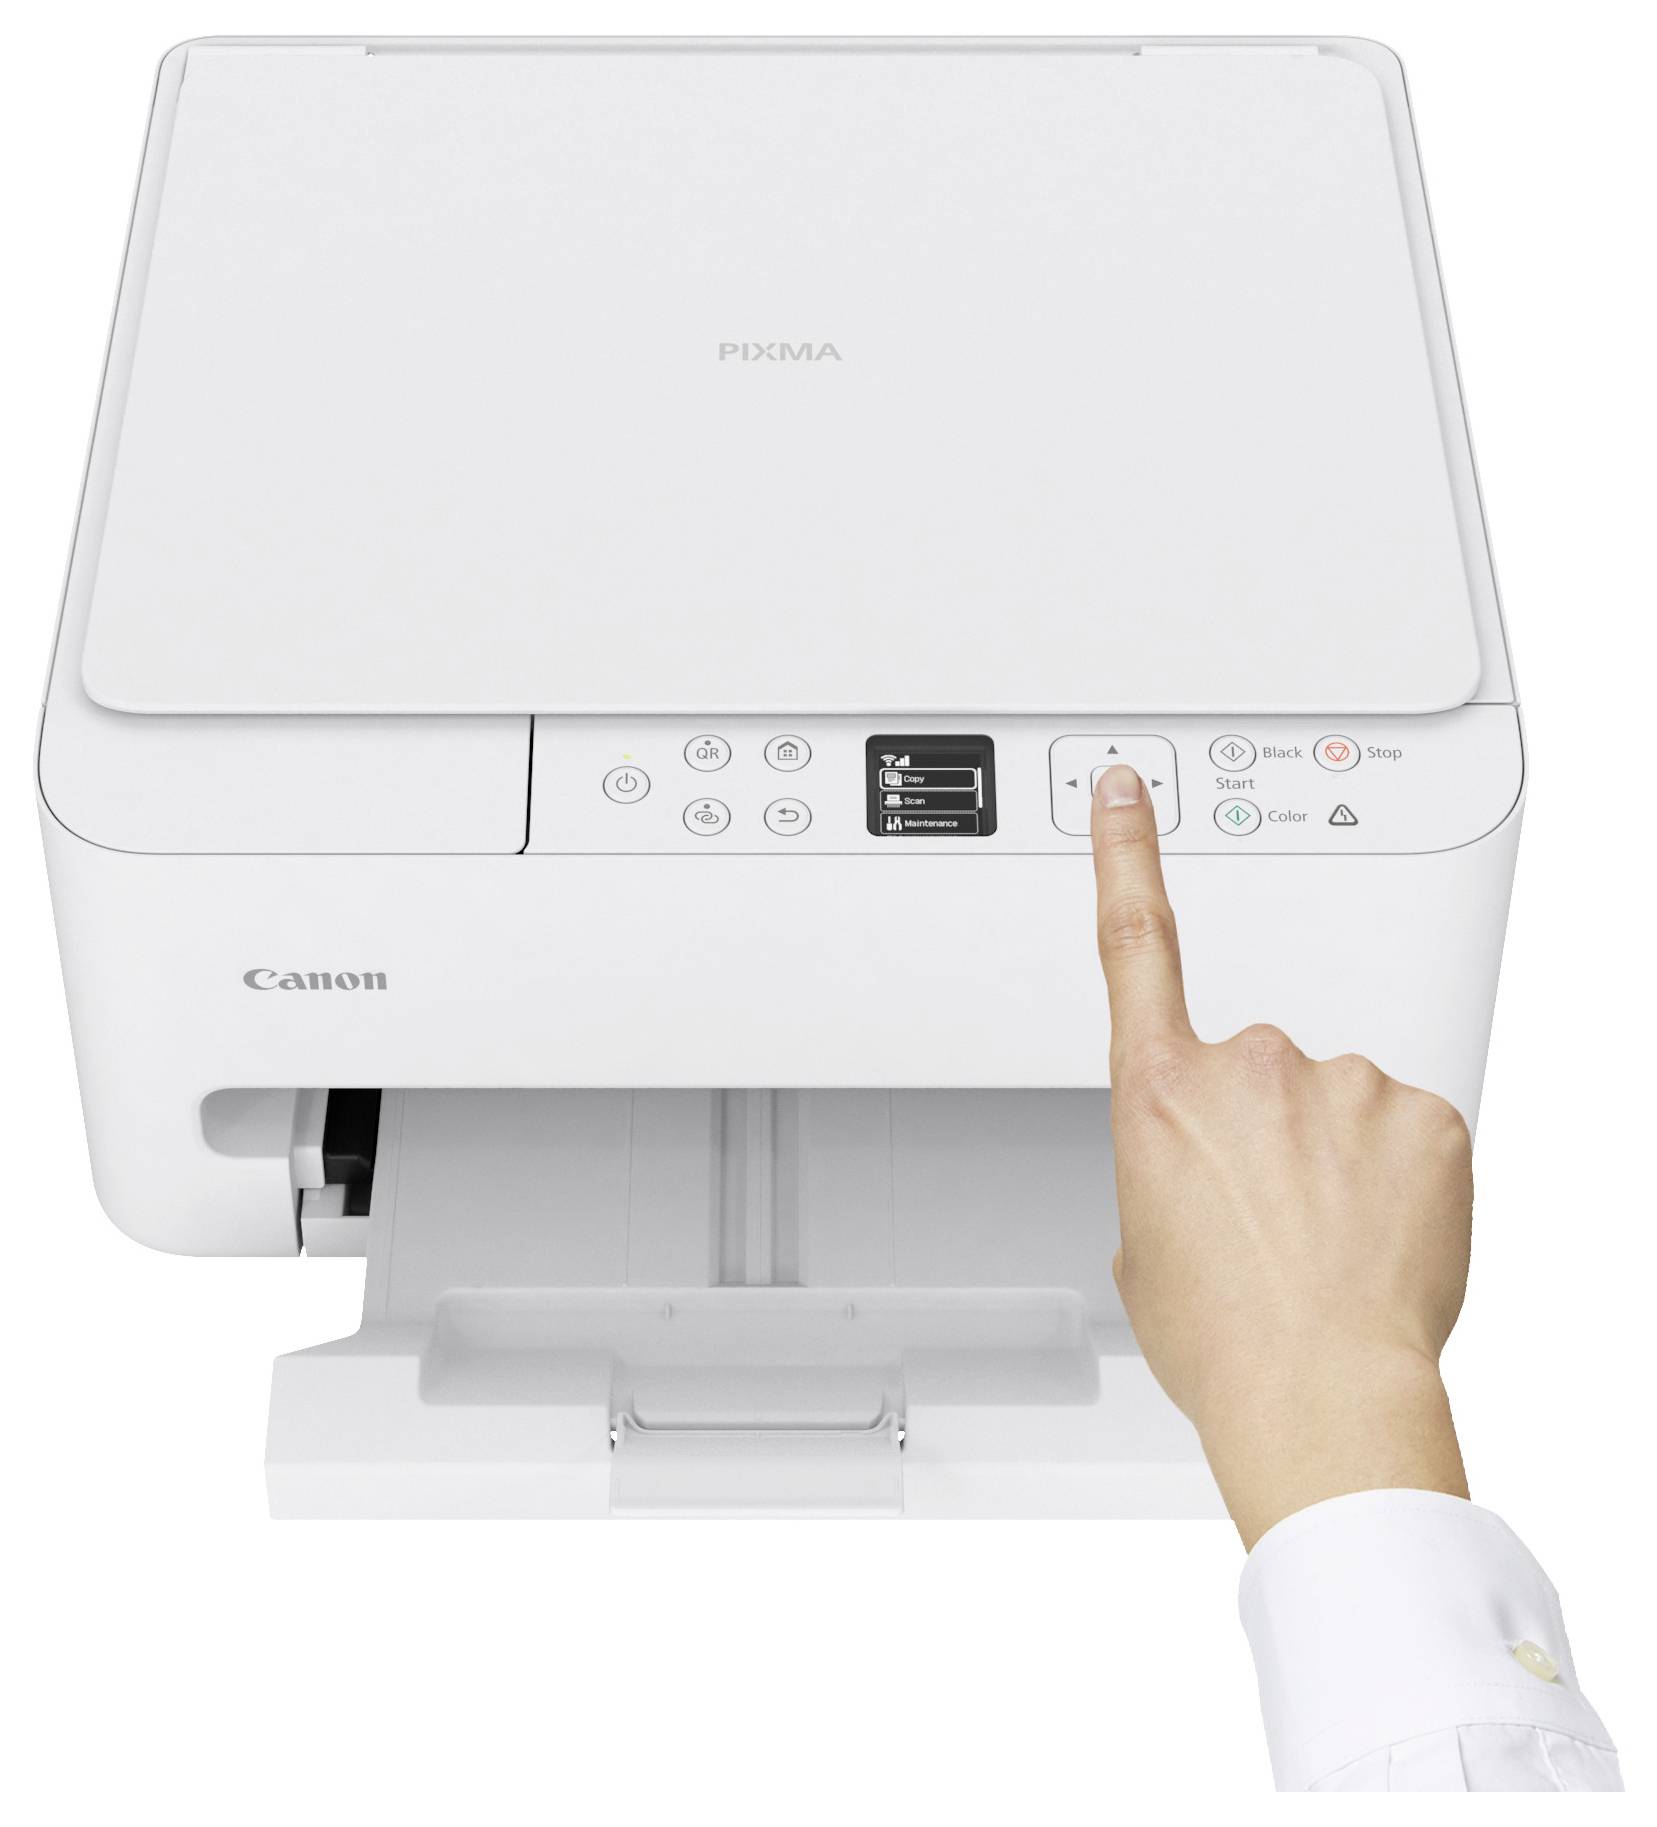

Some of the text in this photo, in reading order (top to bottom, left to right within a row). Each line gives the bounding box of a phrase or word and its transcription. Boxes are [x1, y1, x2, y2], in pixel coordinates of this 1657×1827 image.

[718, 343, 843, 361] PIXMA
[696, 747, 720, 760] QR
[1262, 745, 1303, 759] Black
[1367, 746, 1403, 762] Stop
[903, 775, 925, 784] Copy
[1215, 777, 1255, 790] Start
[904, 797, 926, 805] Scan
[1267, 810, 1309, 823] Color
[904, 819, 958, 828] Maintenance
[243, 969, 388, 990] Canon
